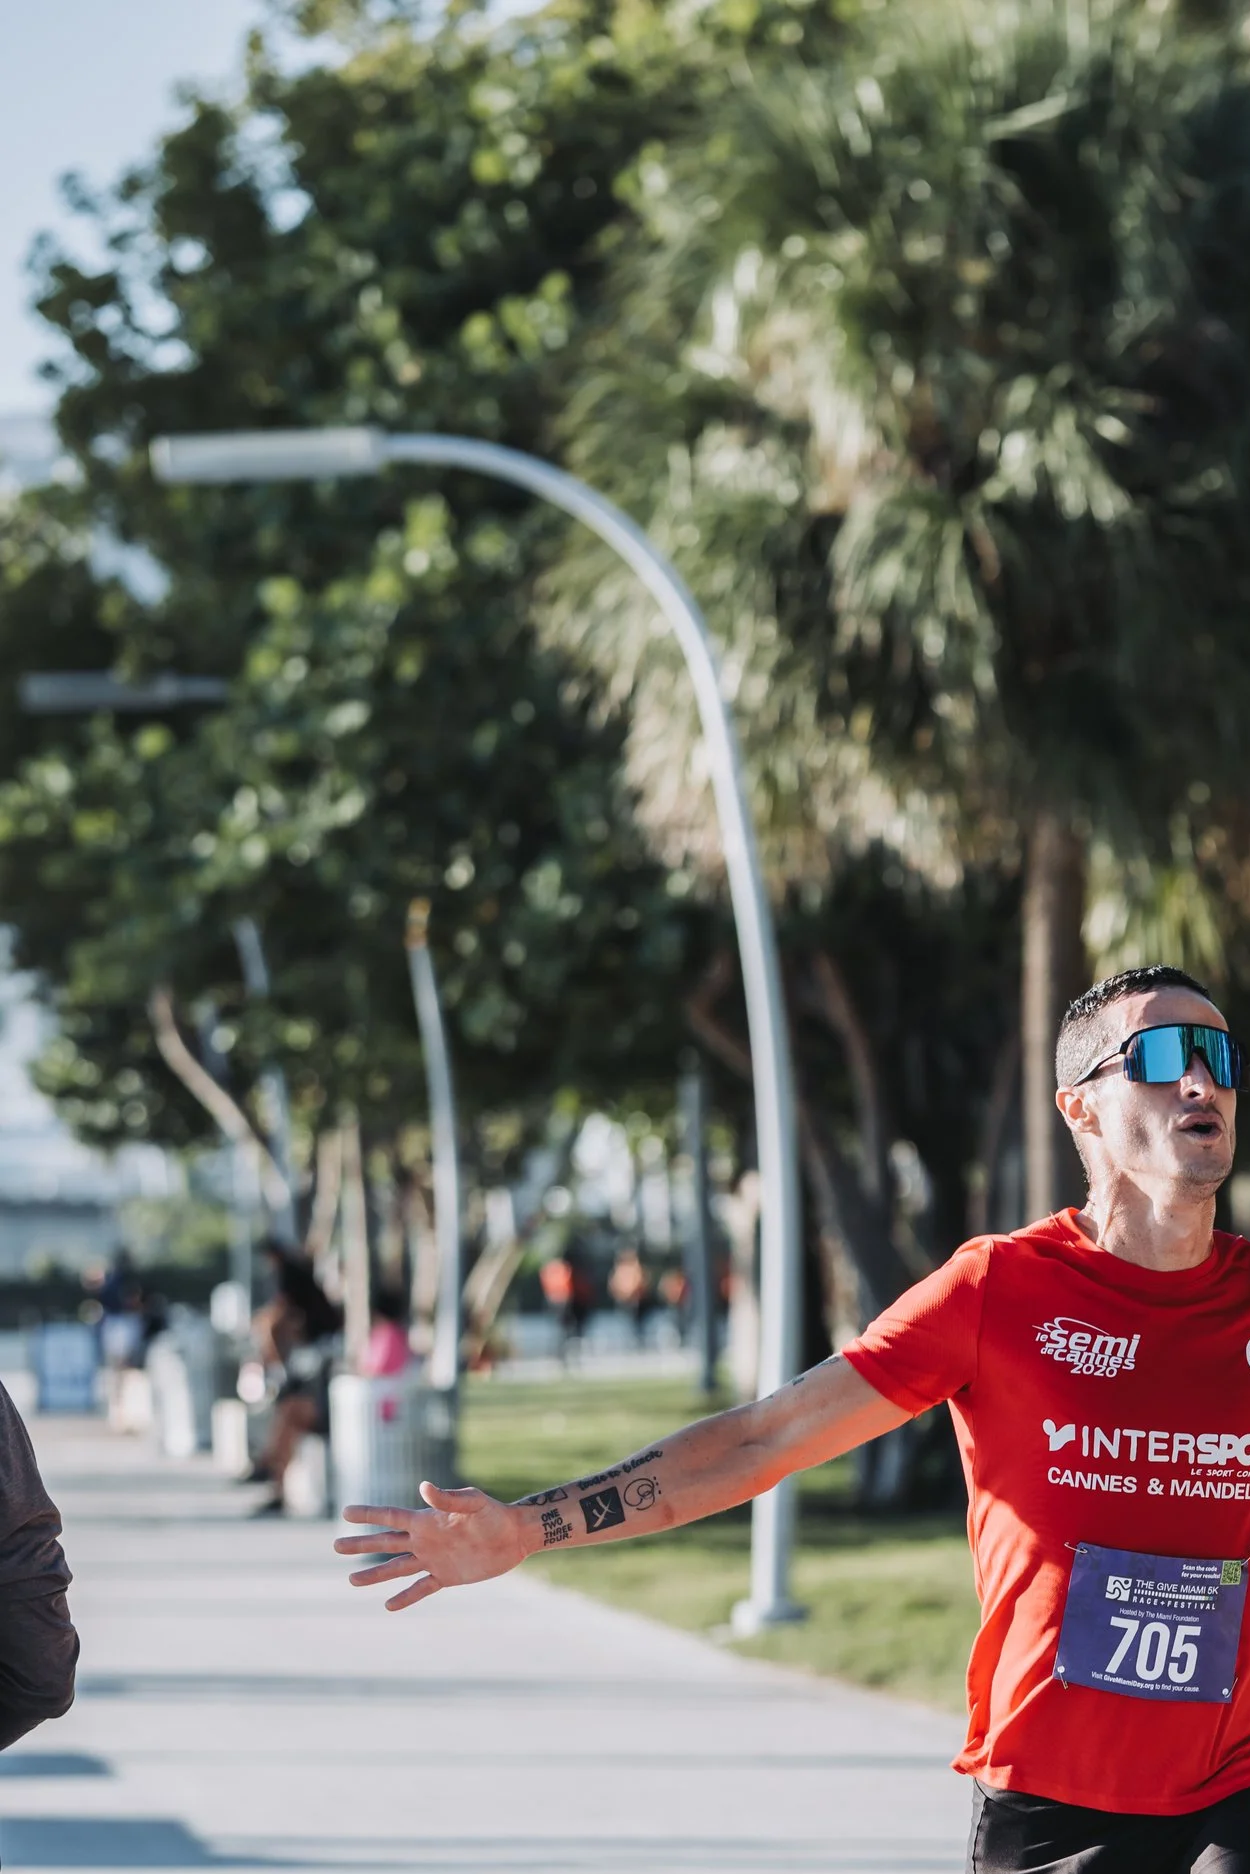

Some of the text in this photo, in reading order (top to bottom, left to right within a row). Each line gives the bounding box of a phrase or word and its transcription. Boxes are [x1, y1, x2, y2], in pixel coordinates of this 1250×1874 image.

[1036, 1329, 1141, 1358] le semi
[1070, 1362, 1118, 1378] 2020
[1048, 1467, 1137, 1493] CANNES
[1147, 1478, 1164, 1495] &
[1206, 1469, 1235, 1477] SPORT
[541, 1508, 560, 1522] ONE
[542, 1517, 563, 1531] TWO
[544, 1523, 573, 1538] THREE
[1136, 1579, 1219, 1595] THE GIVE MIAMI 5K
[1119, 1607, 1138, 1617] Hosted
[1139, 1610, 1145, 1618] by
[1172, 1615, 1200, 1623] Foundation
[1105, 1616, 1201, 1683] 705
[1091, 1671, 1103, 1680] Visit
[1103, 1674, 1154, 1690] GiveMiamiDay.org
[1161, 1683, 1171, 1691] find
